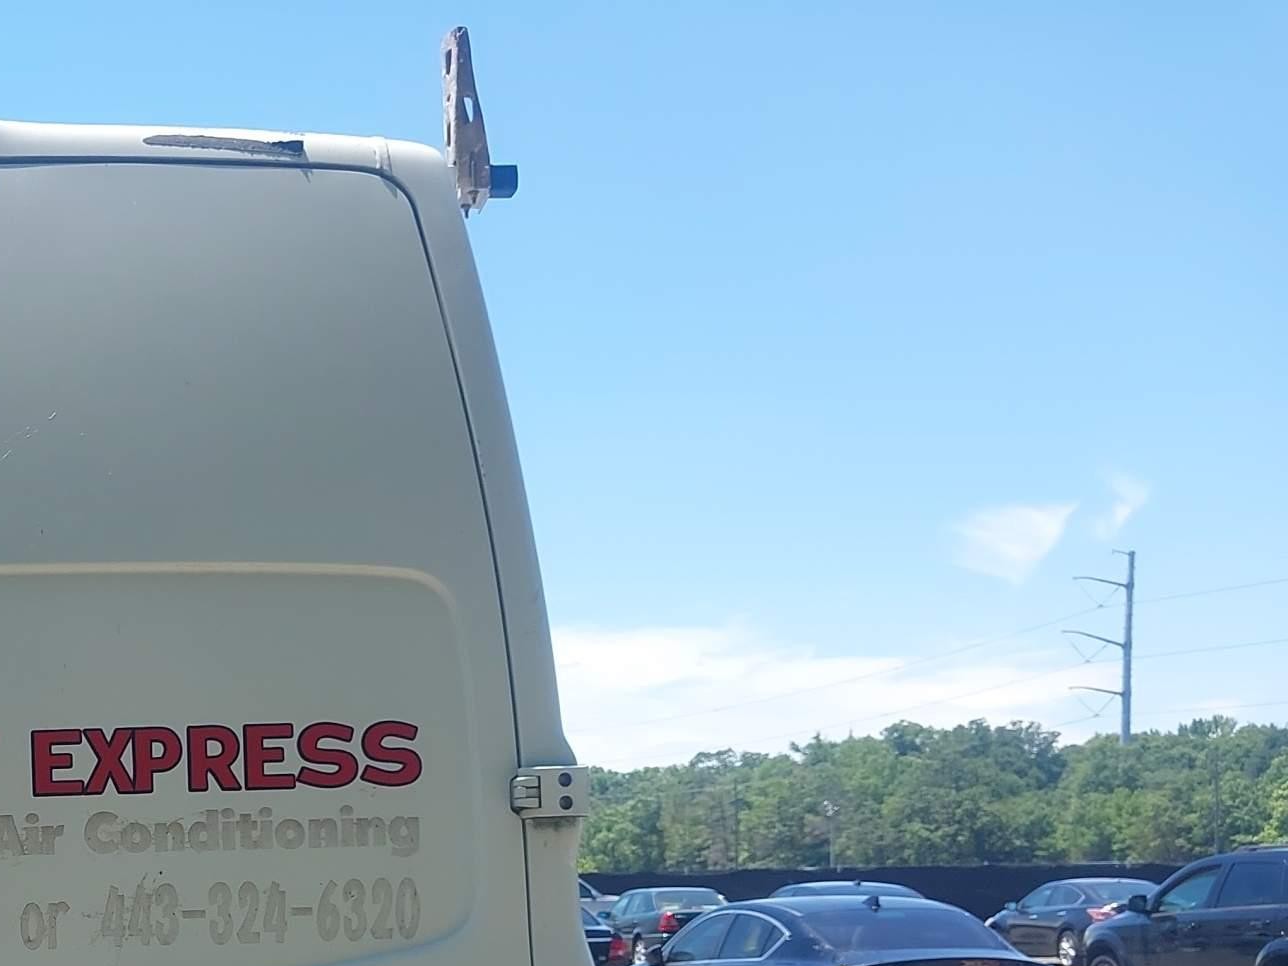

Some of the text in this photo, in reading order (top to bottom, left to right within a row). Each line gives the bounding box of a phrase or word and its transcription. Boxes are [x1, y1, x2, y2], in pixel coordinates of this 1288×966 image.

[31, 720, 423, 797] EXPRESS
[83, 805, 420, 858] Conditioning
[20, 901, 70, 950] or
